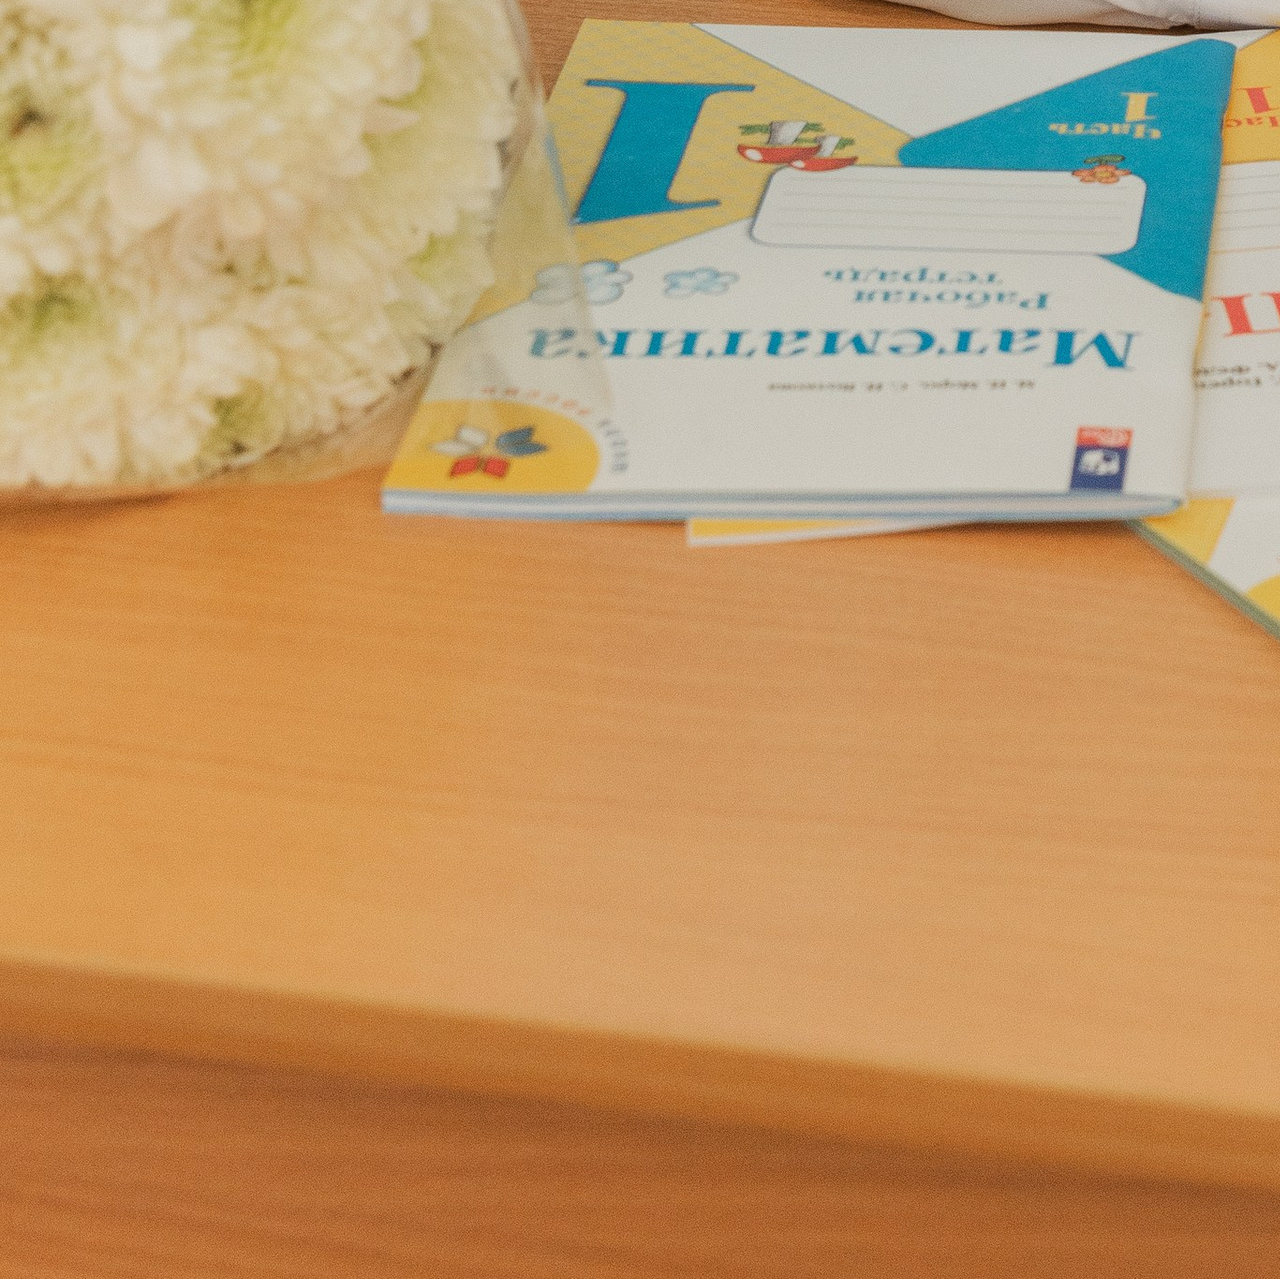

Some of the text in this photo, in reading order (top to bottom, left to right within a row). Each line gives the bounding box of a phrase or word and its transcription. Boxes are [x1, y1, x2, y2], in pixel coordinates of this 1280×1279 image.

[1048, 121, 1162, 141] Часть
[823, 266, 1003, 285] тетрадь
[852, 289, 1051, 311] Рабочая
[527, 327, 1145, 371] Математика
